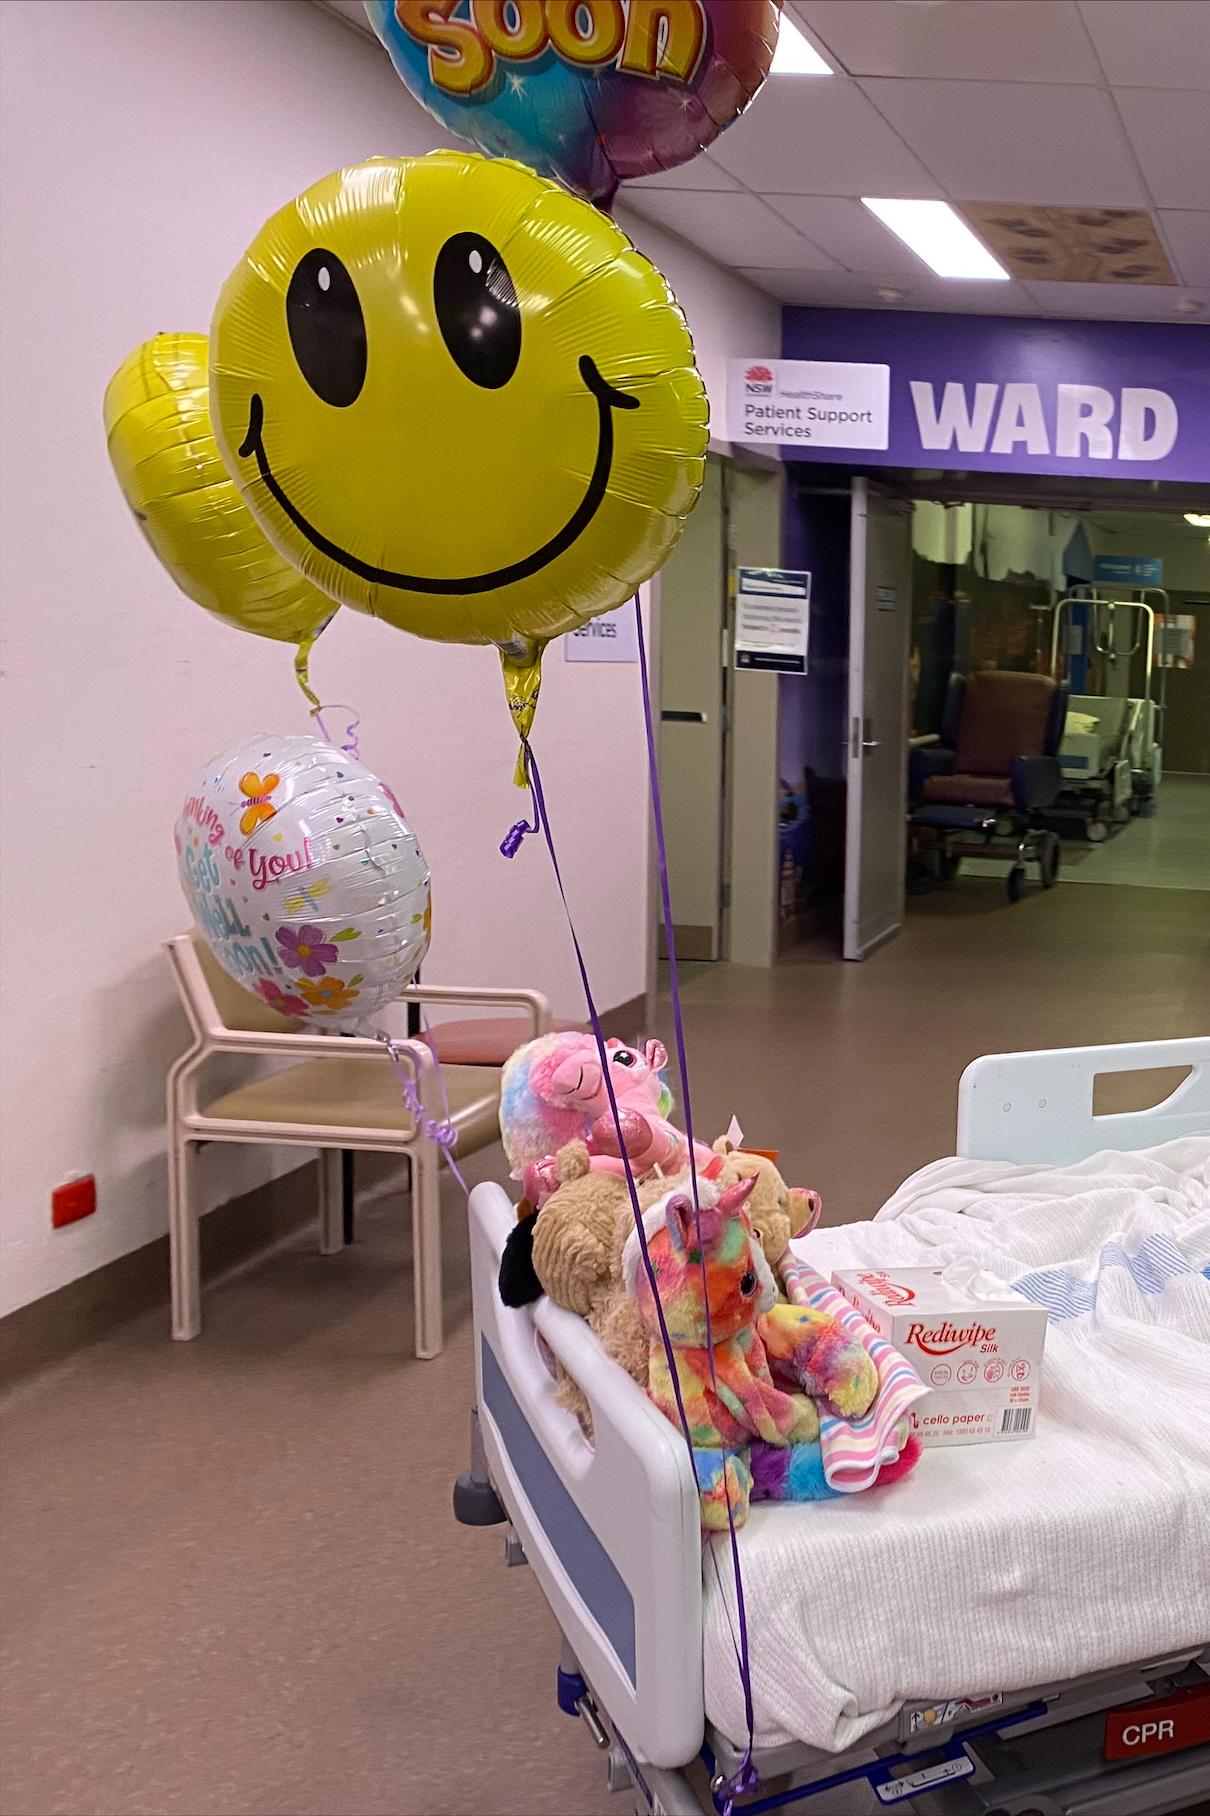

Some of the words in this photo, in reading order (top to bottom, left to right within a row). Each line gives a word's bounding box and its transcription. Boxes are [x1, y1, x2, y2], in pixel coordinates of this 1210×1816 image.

[745, 383, 773, 393] NSW
[744, 404, 802, 420] Patient
[807, 407, 873, 423] Support
[909, 381, 1178, 461] WARD
[743, 422, 812, 438] Services
[224, 845, 248, 871] of
[248, 836, 313, 890] You!
[903, 1320, 997, 1351] Rediwipe
[980, 1343, 999, 1353] Silk
[923, 1414, 949, 1425] cello
[952, 1413, 985, 1425] paper
[1121, 1719, 1175, 1746] CPR
